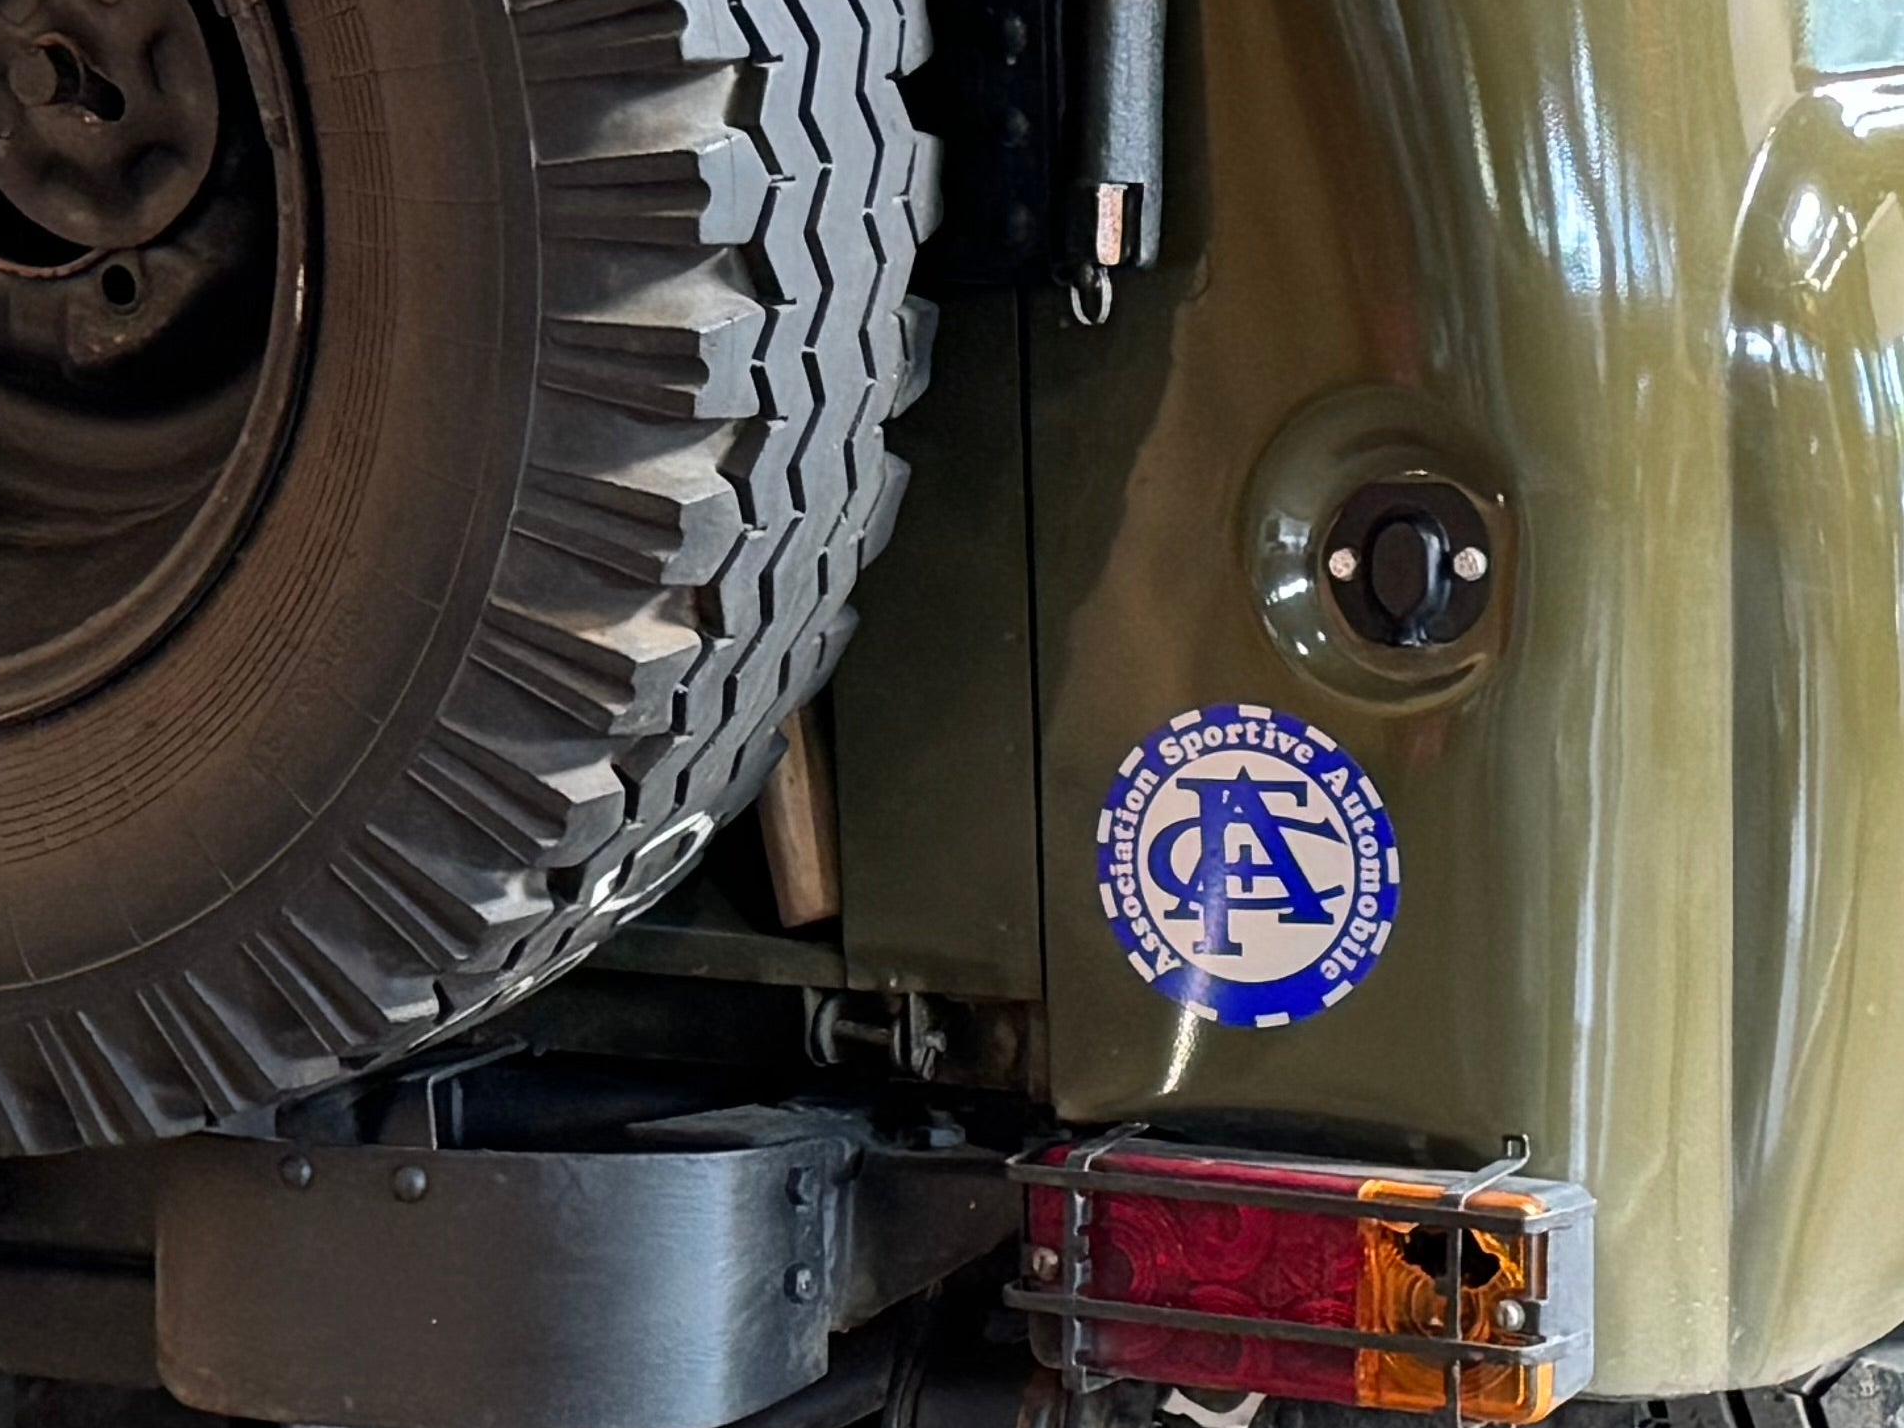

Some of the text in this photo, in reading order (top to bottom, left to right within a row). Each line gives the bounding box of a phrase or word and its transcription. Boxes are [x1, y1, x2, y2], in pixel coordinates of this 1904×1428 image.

[1110, 768, 1182, 976] Association
[1158, 721, 1315, 766] Sportive
[1320, 766, 1381, 981] Automobile
